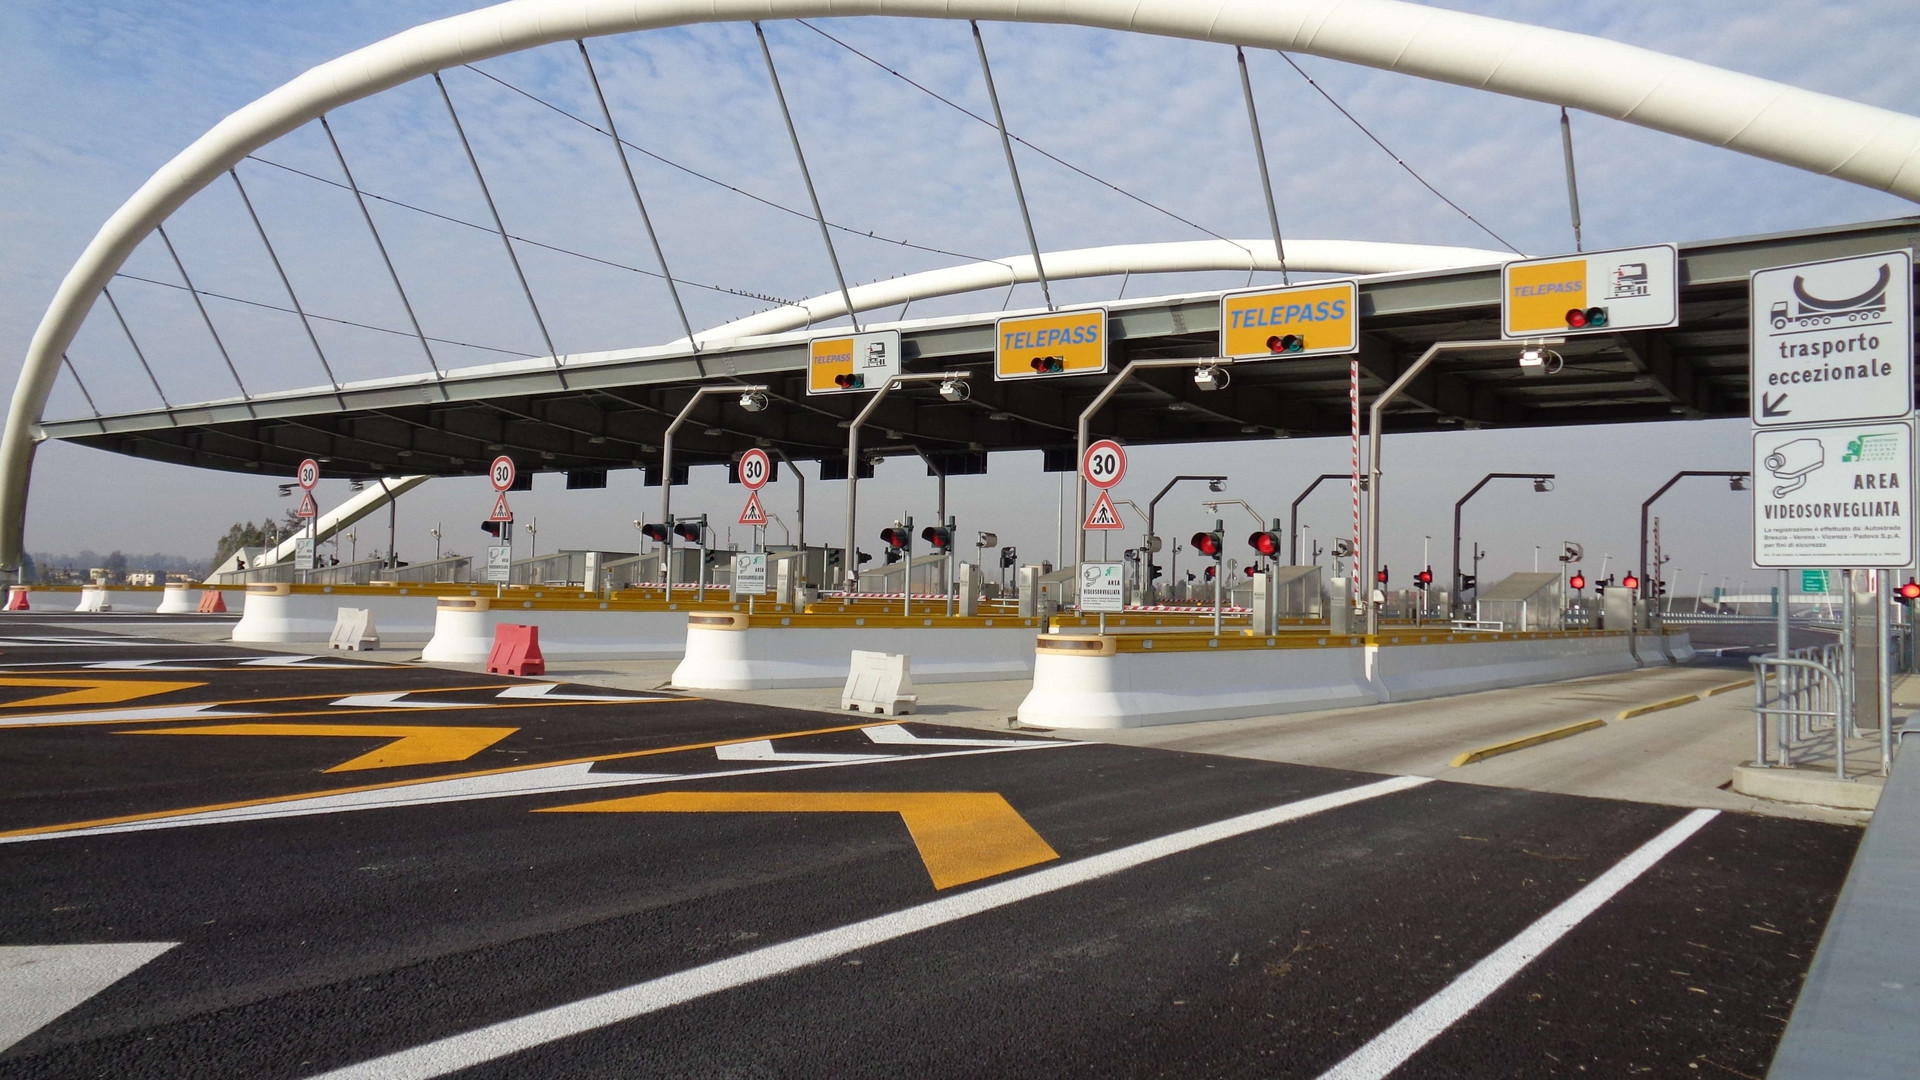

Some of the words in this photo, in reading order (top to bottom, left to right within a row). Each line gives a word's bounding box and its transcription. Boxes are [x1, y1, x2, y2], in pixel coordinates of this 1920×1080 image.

[1514, 280, 1583, 297] TELEPASS
[1231, 300, 1345, 328] TELEPASS
[1004, 325, 1098, 350] TELEPASS
[1779, 333, 1880, 358] trasporto
[813, 353, 851, 364] TELEPASS
[1768, 359, 1892, 386] eccezionale
[746, 461, 762, 478] 30
[1093, 454, 1116, 475] 30
[303, 468, 313, 481] 30
[496, 466, 508, 481] 30
[1853, 473, 1900, 490] AREA
[1764, 501, 1900, 519] VIDEOSORVEGLIATA
